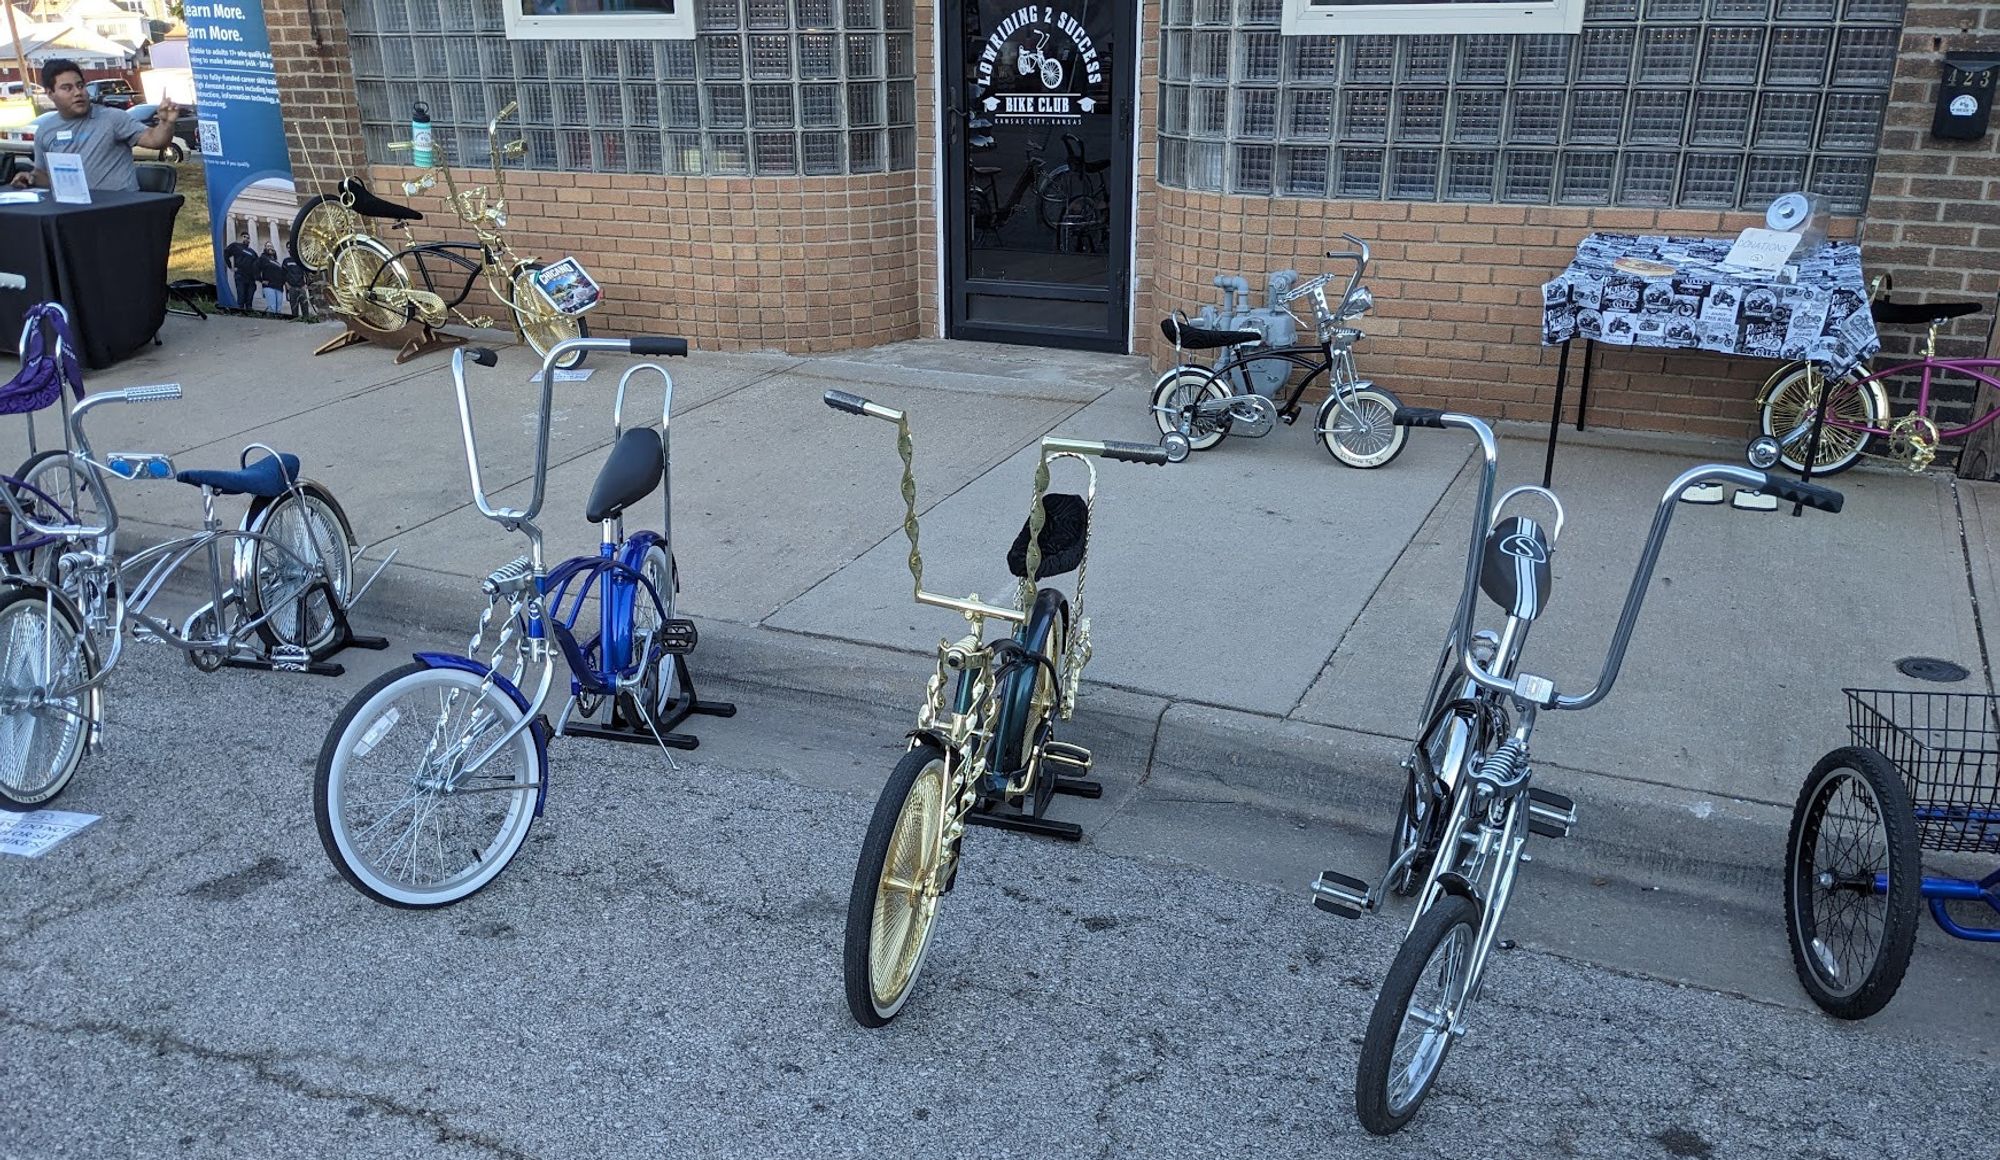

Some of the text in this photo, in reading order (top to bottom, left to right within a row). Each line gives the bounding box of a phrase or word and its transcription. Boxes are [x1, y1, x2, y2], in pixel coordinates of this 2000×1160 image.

[213, 3, 246, 20] More.
[186, 25, 244, 42] arn More.
[978, 5, 1102, 86] LOWRIDING 2 SUCCESS
[1946, 69, 1990, 88] 423
[221, 92, 251, 100] information
[1005, 97, 1070, 113] BIKE CLUB
[1051, 118, 1082, 126] KANSAS
[1737, 239, 1787, 252] DONATIONS
[539, 263, 575, 285] CHICANO
